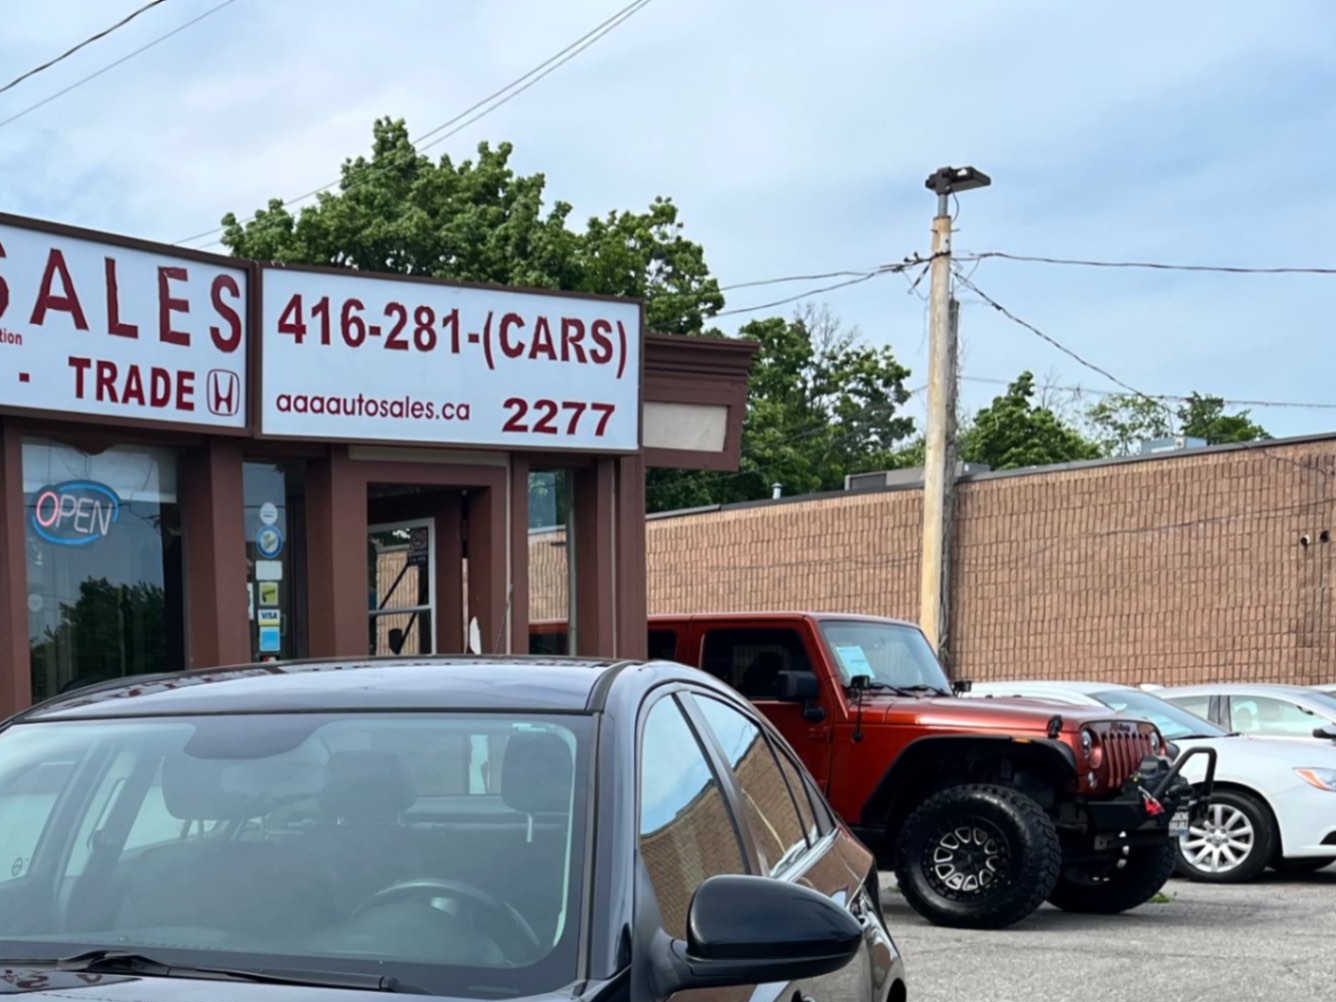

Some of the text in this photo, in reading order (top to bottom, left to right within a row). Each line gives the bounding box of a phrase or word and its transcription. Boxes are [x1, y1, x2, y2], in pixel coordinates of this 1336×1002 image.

[277, 294, 628, 379] 416-281-(CARS)
[68, 356, 195, 411] TRADE
[276, 393, 470, 421] aaaautosales.ca
[502, 397, 615, 437] 2277
[36, 491, 113, 536] OPEN
[260, 612, 278, 620] VISA
